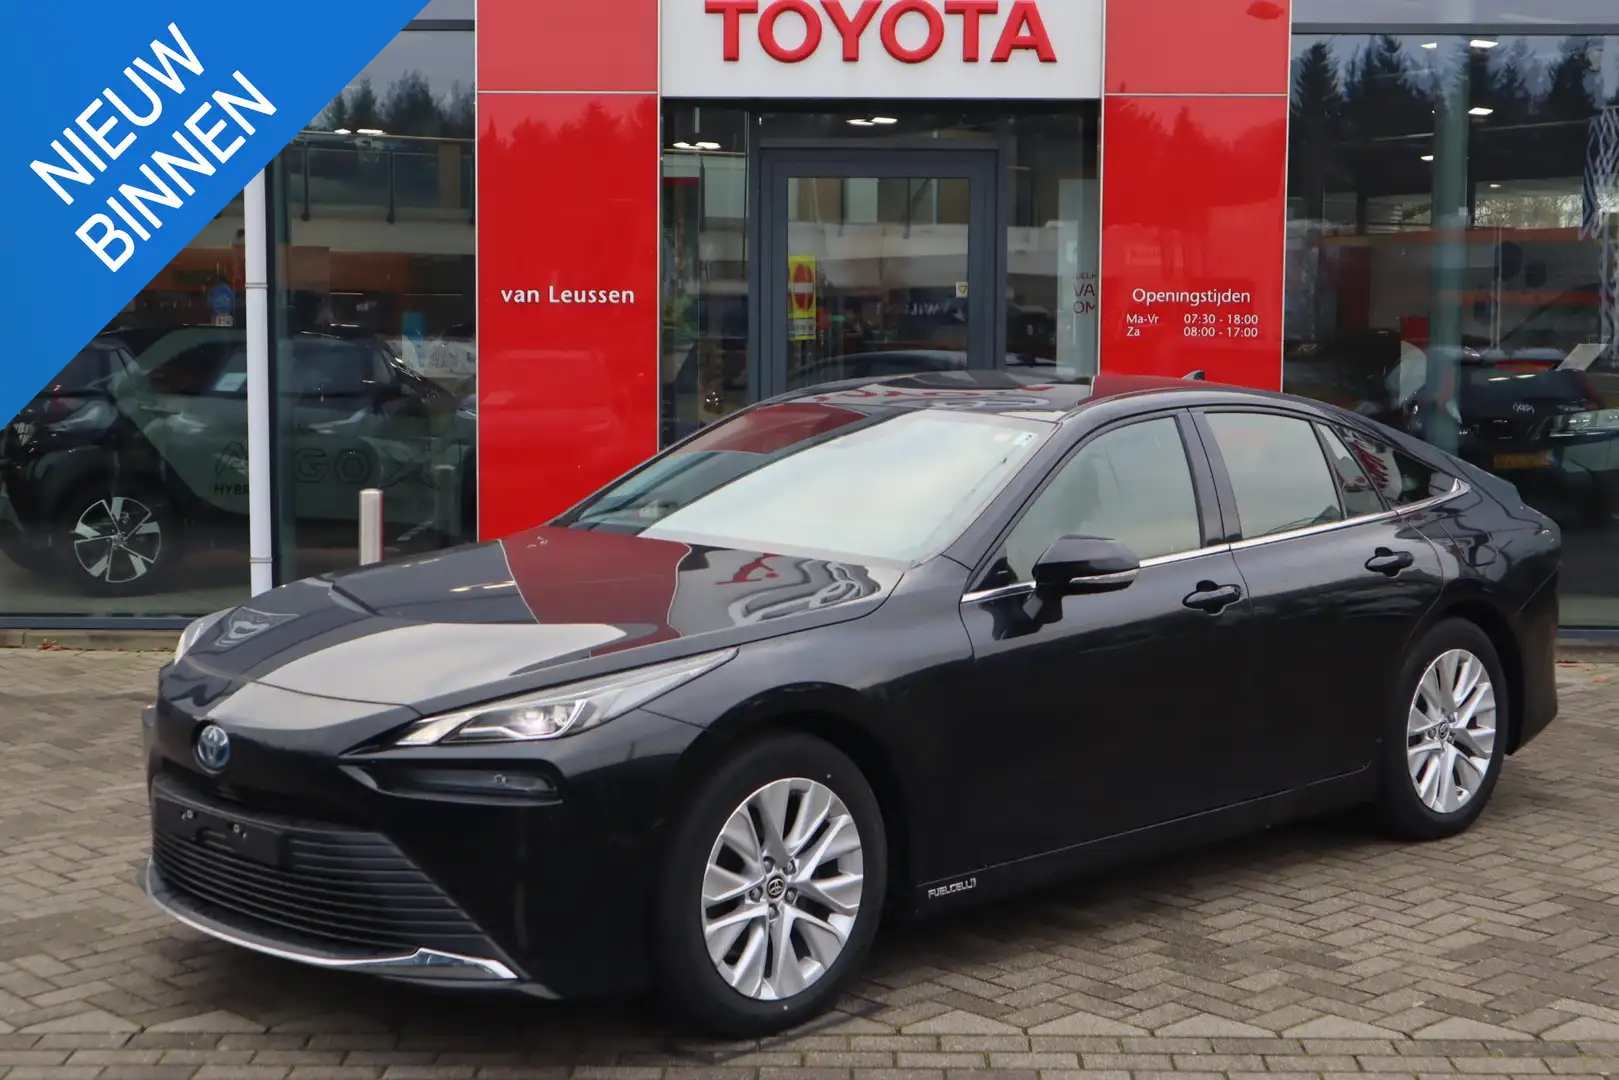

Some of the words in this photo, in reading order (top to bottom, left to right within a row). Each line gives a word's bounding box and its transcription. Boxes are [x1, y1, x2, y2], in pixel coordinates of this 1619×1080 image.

[705, 0, 1057, 63] TOYOTA
[500, 289, 540, 303] van
[548, 285, 635, 304] Leussen
[1132, 288, 1251, 306] Openingstijden
[1126, 313, 1160, 325] Ma-Vr
[1183, 313, 1216, 325] 07:30
[1227, 313, 1259, 325] 18:00
[1126, 326, 1141, 337] Za
[1183, 326, 1216, 337] 08:00
[1226, 326, 1259, 338] 17:00
[214, 483, 249, 496] HYBR
